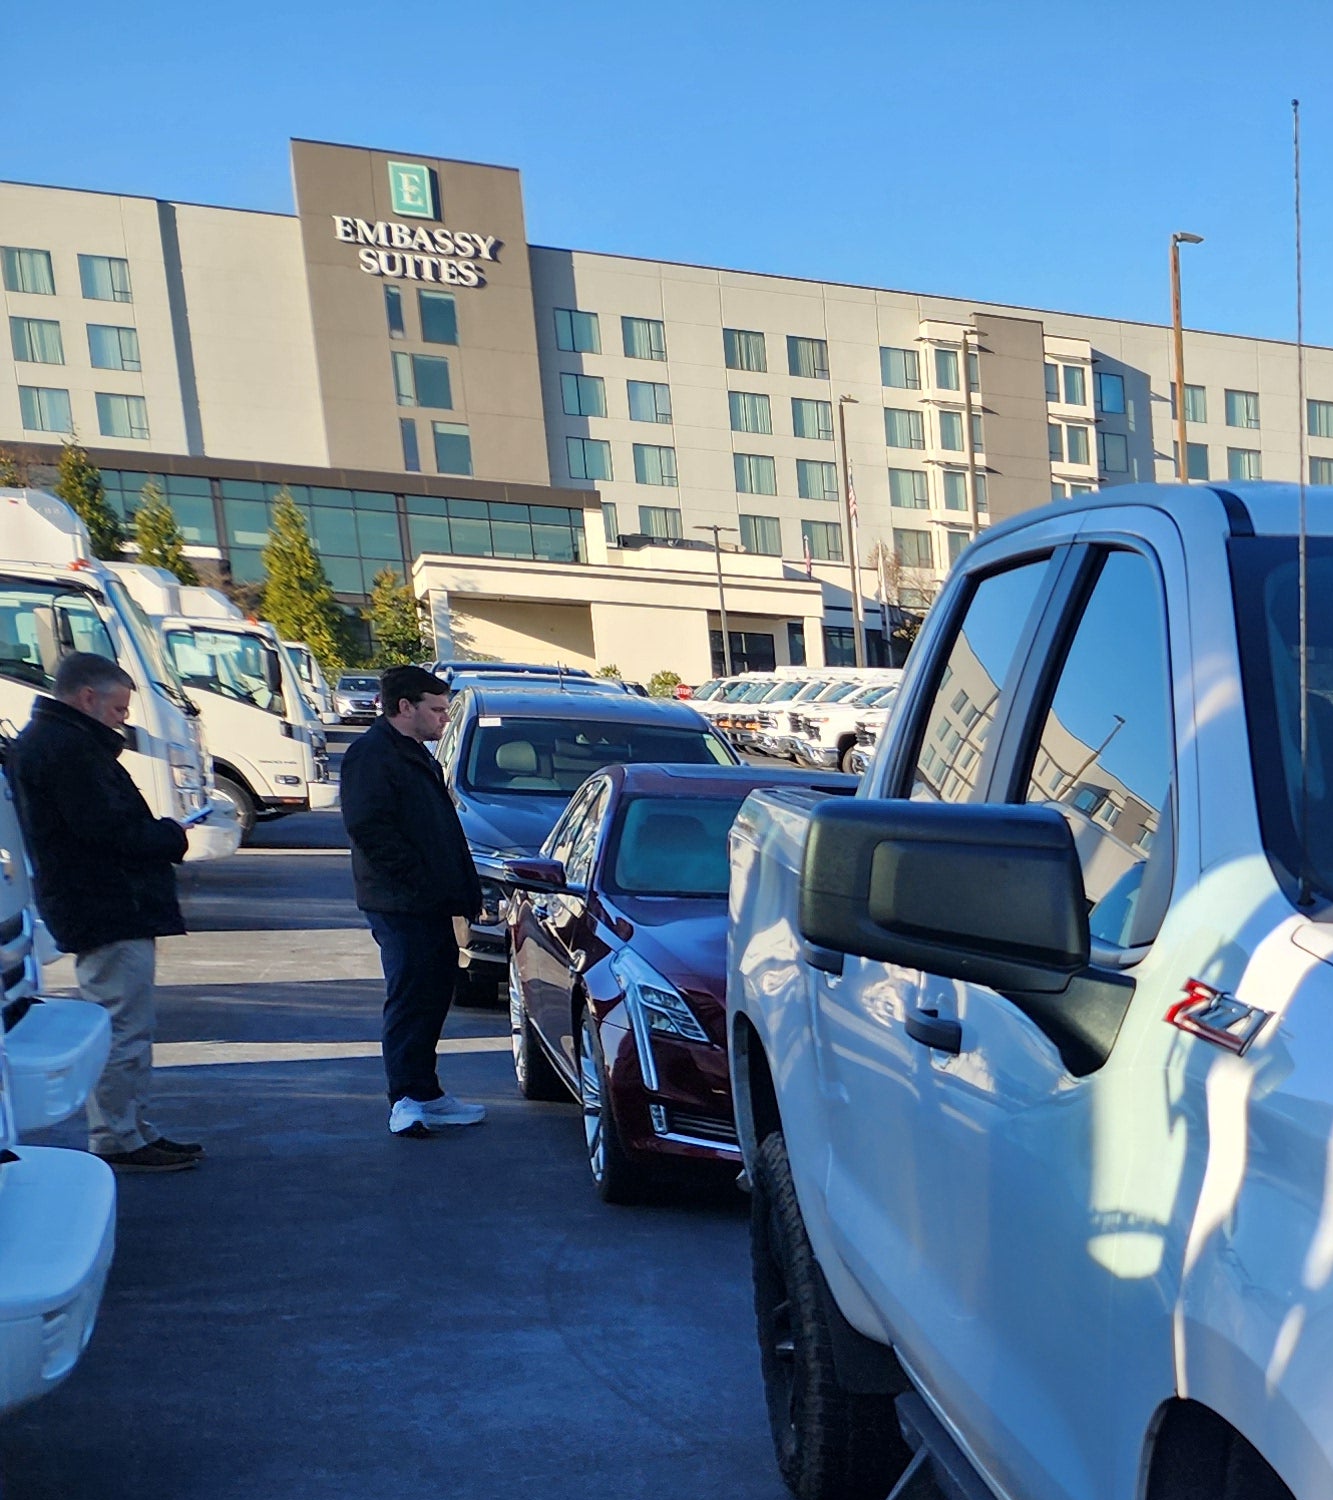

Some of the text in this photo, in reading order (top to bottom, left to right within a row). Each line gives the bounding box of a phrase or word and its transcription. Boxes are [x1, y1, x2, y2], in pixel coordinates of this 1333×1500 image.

[398, 172, 424, 206] E
[331, 215, 496, 262] EMBASSY
[358, 249, 480, 288] SUITES
